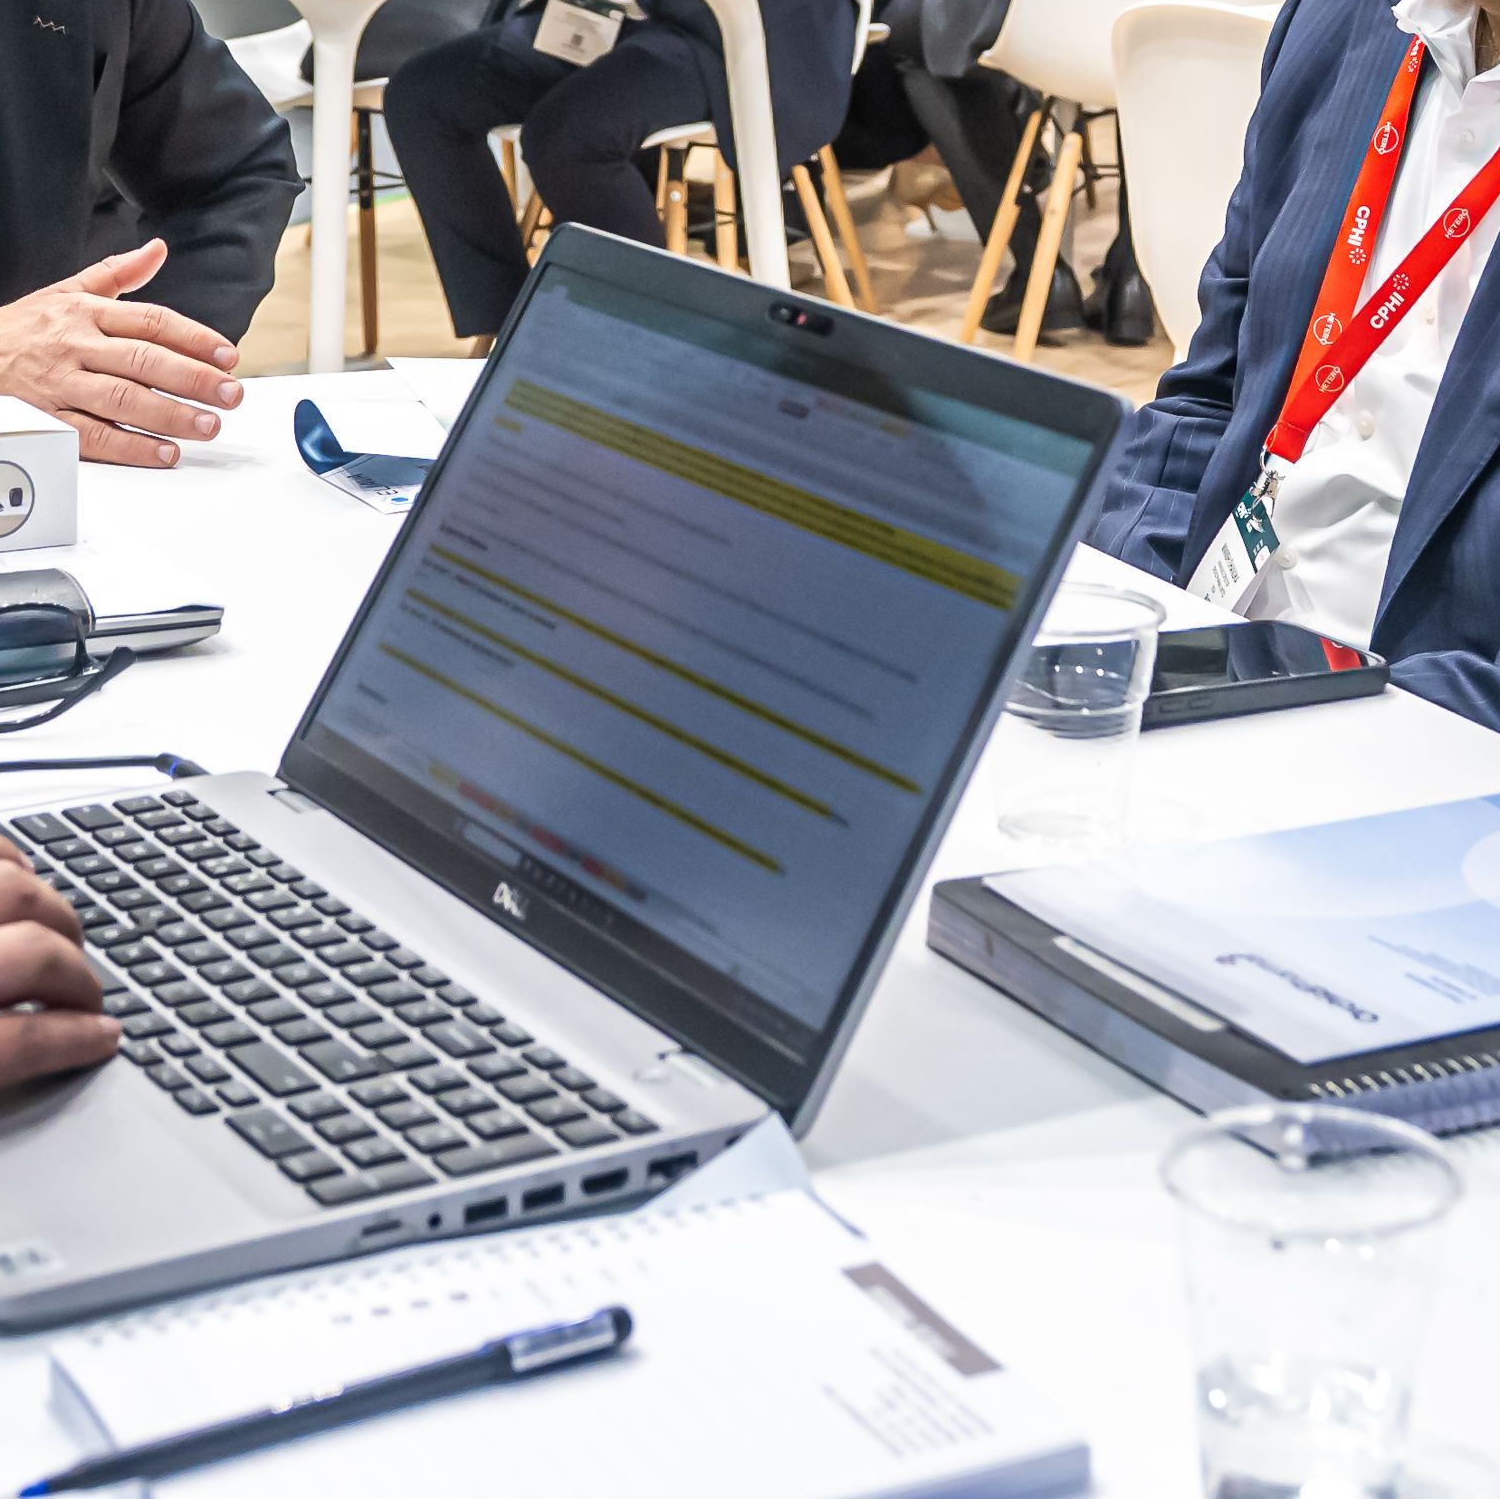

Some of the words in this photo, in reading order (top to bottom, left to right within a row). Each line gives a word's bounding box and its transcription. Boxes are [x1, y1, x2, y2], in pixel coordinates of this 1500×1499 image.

[1378, 121, 1393, 156] HETERO
[1347, 205, 1371, 247] CPHI
[1444, 208, 1469, 239] HETERO
[1370, 291, 1405, 329] CPHI
[1318, 366, 1341, 393] HETERO
